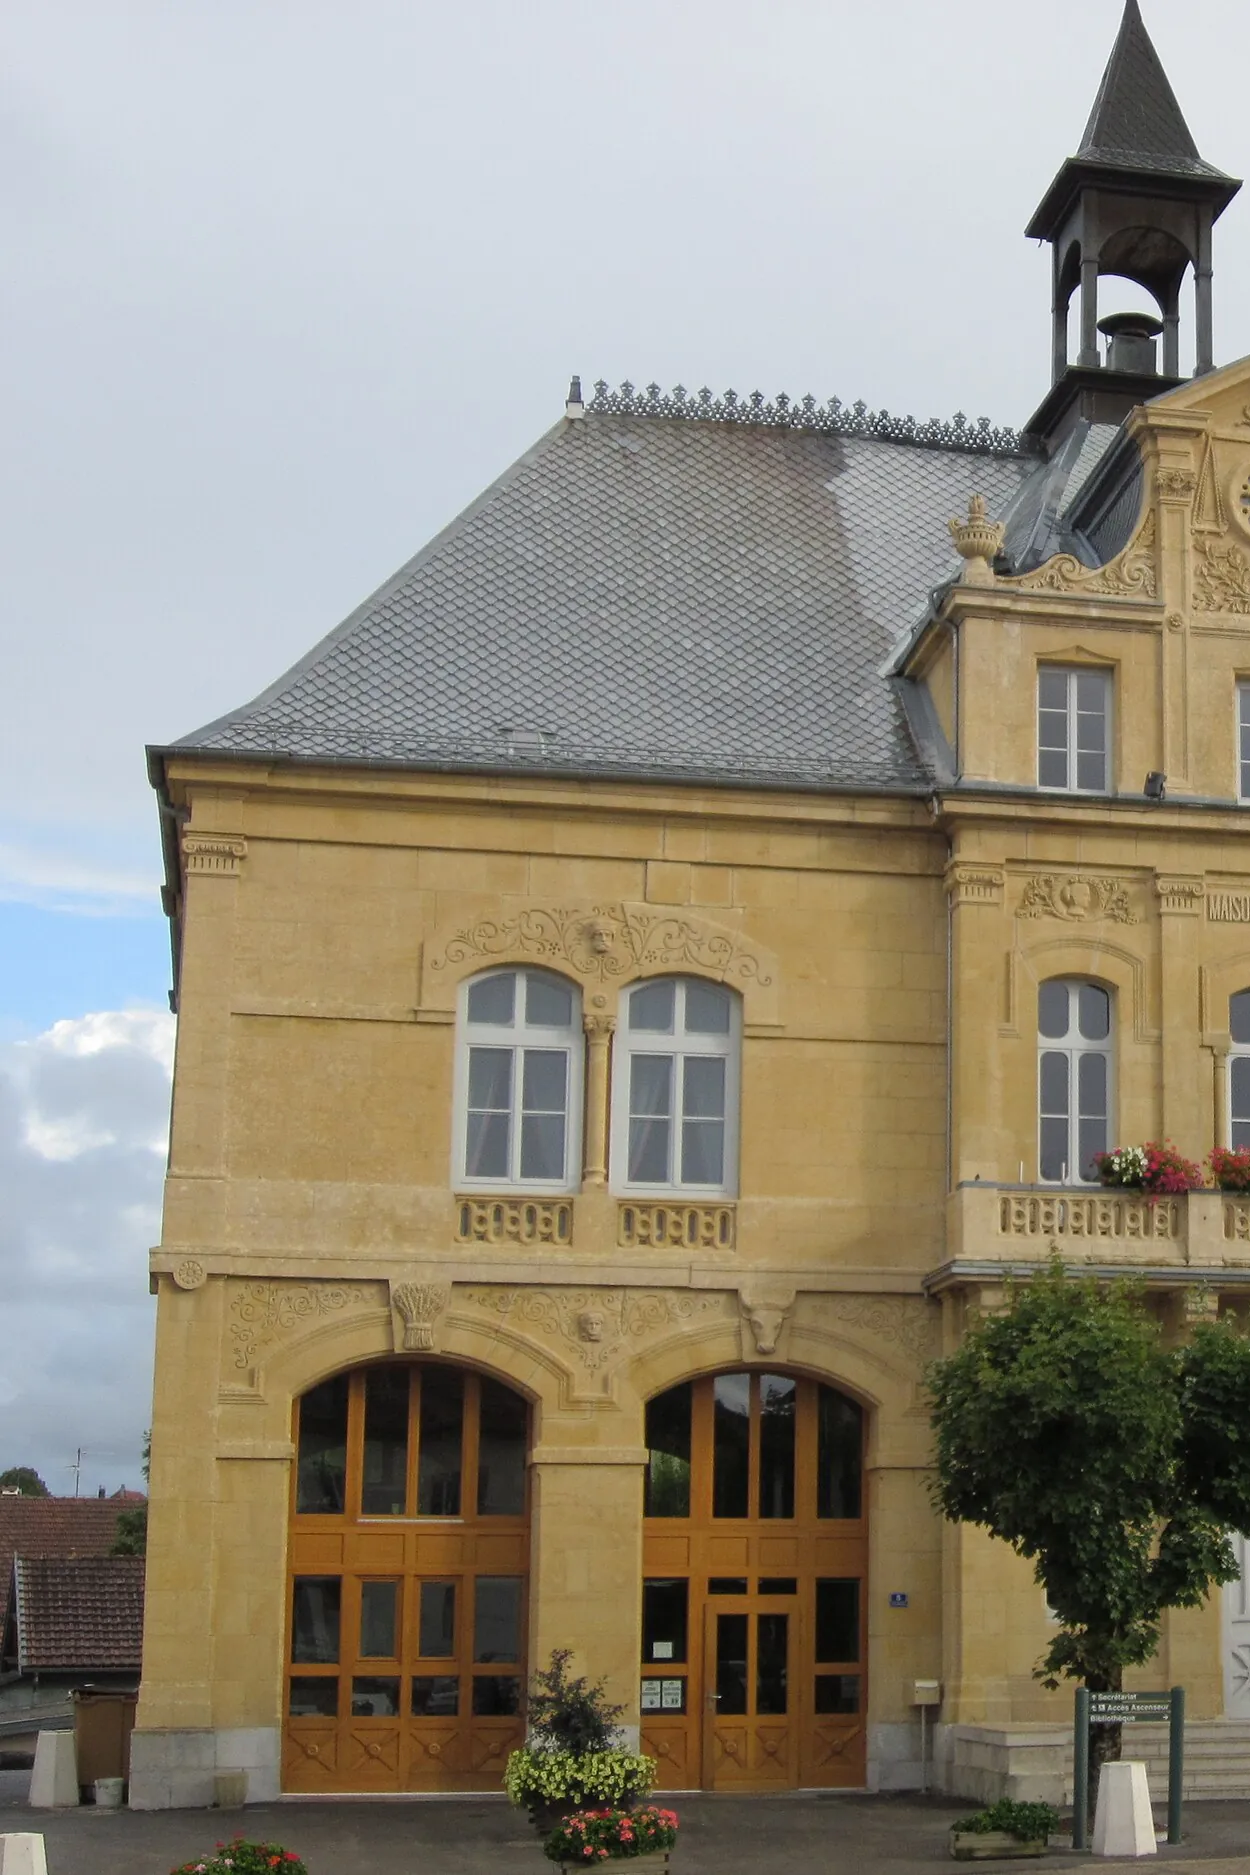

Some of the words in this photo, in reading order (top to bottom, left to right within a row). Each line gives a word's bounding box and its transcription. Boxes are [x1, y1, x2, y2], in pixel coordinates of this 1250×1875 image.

[1098, 1693, 1137, 1701] Secrétariat
[1107, 1703, 1130, 1712] Accès
[1131, 1704, 1169, 1712] Ascenseur
[1090, 1714, 1136, 1723] Bibliothèque
